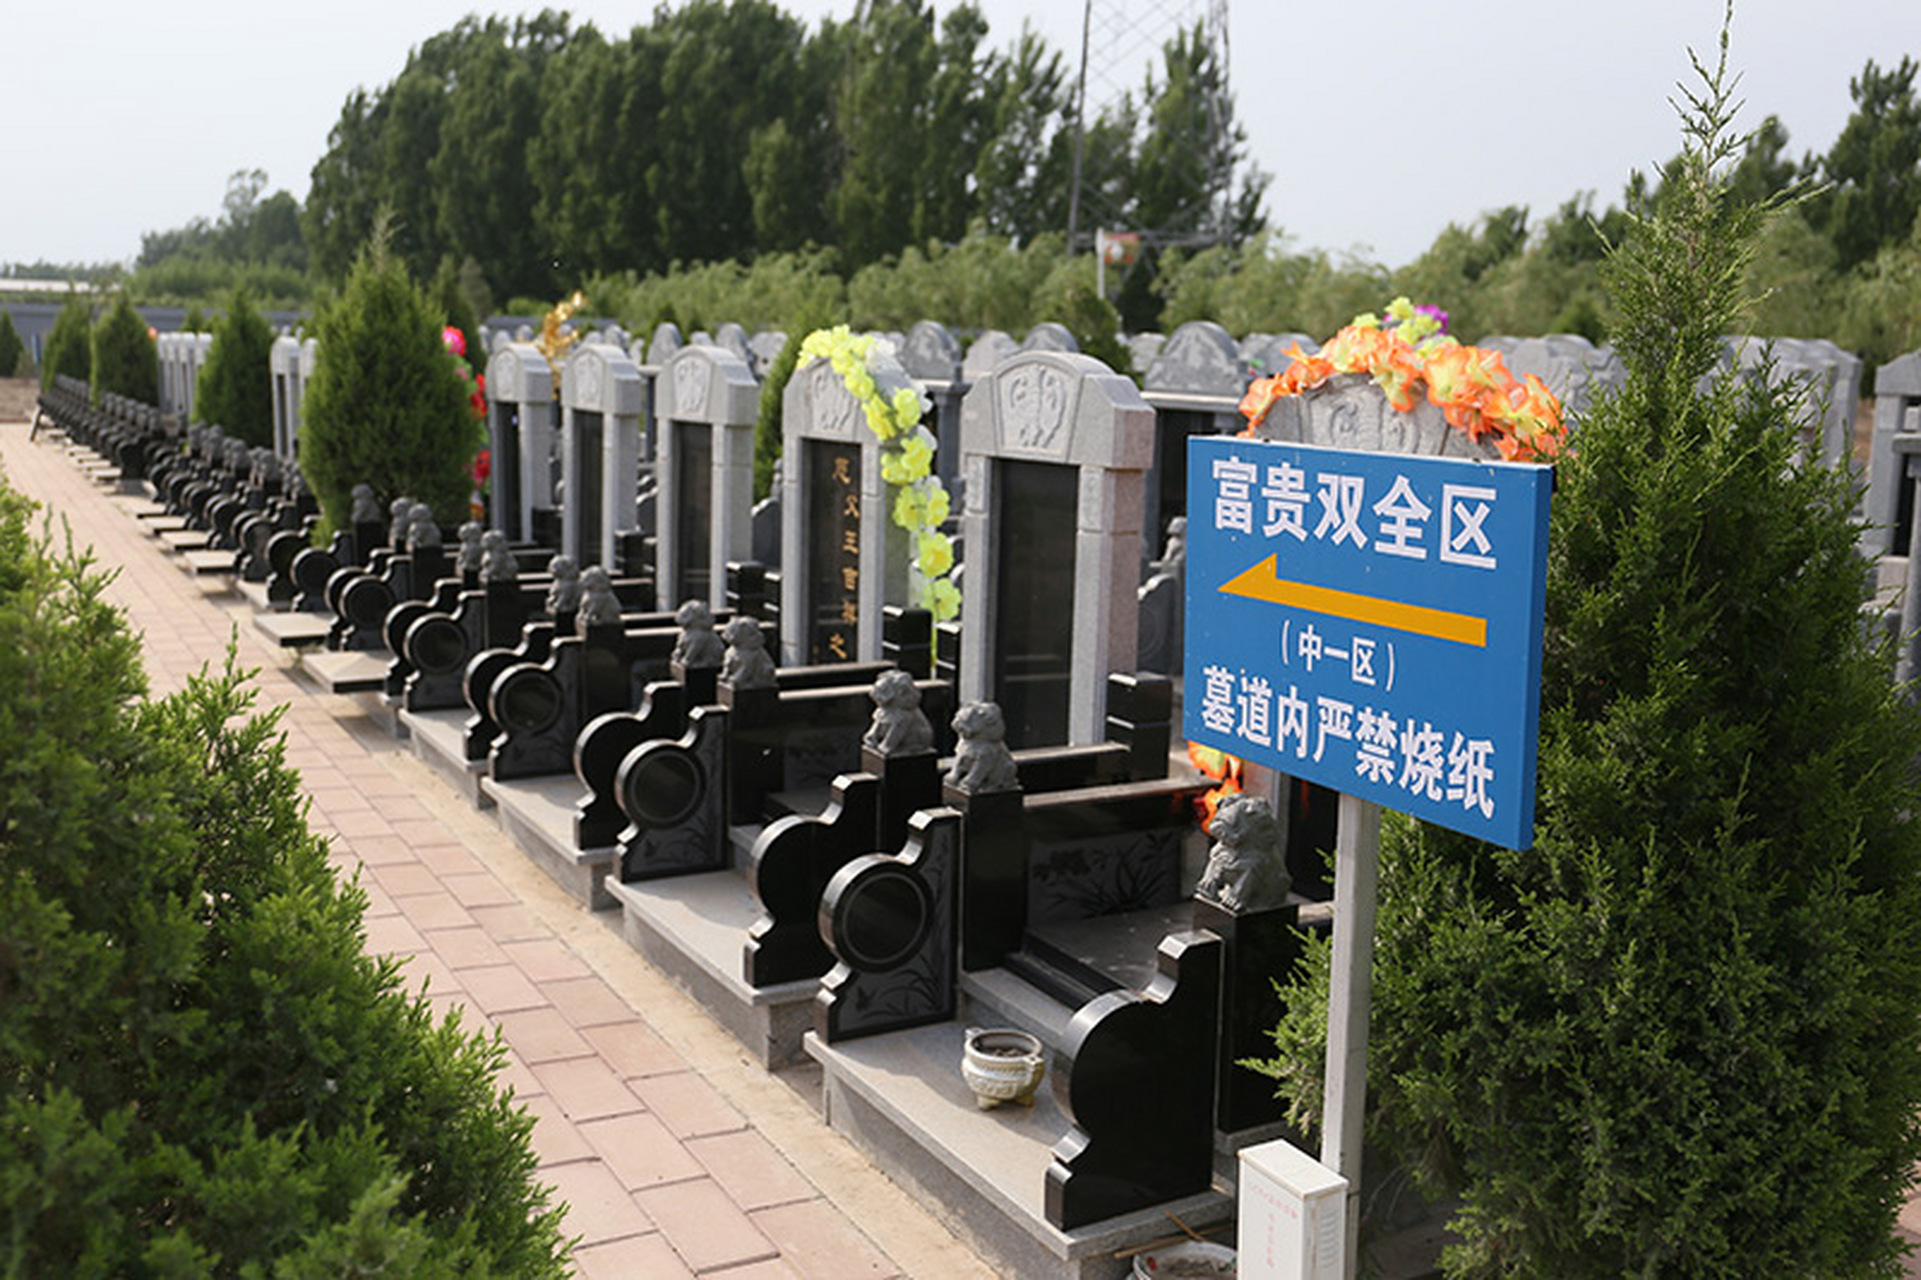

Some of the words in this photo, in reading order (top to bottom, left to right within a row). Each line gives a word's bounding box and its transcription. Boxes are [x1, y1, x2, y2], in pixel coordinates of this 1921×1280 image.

[1212, 456, 1497, 569] 富贵双全区
[1202, 665, 1495, 819] 墓道内严禁烧纸
